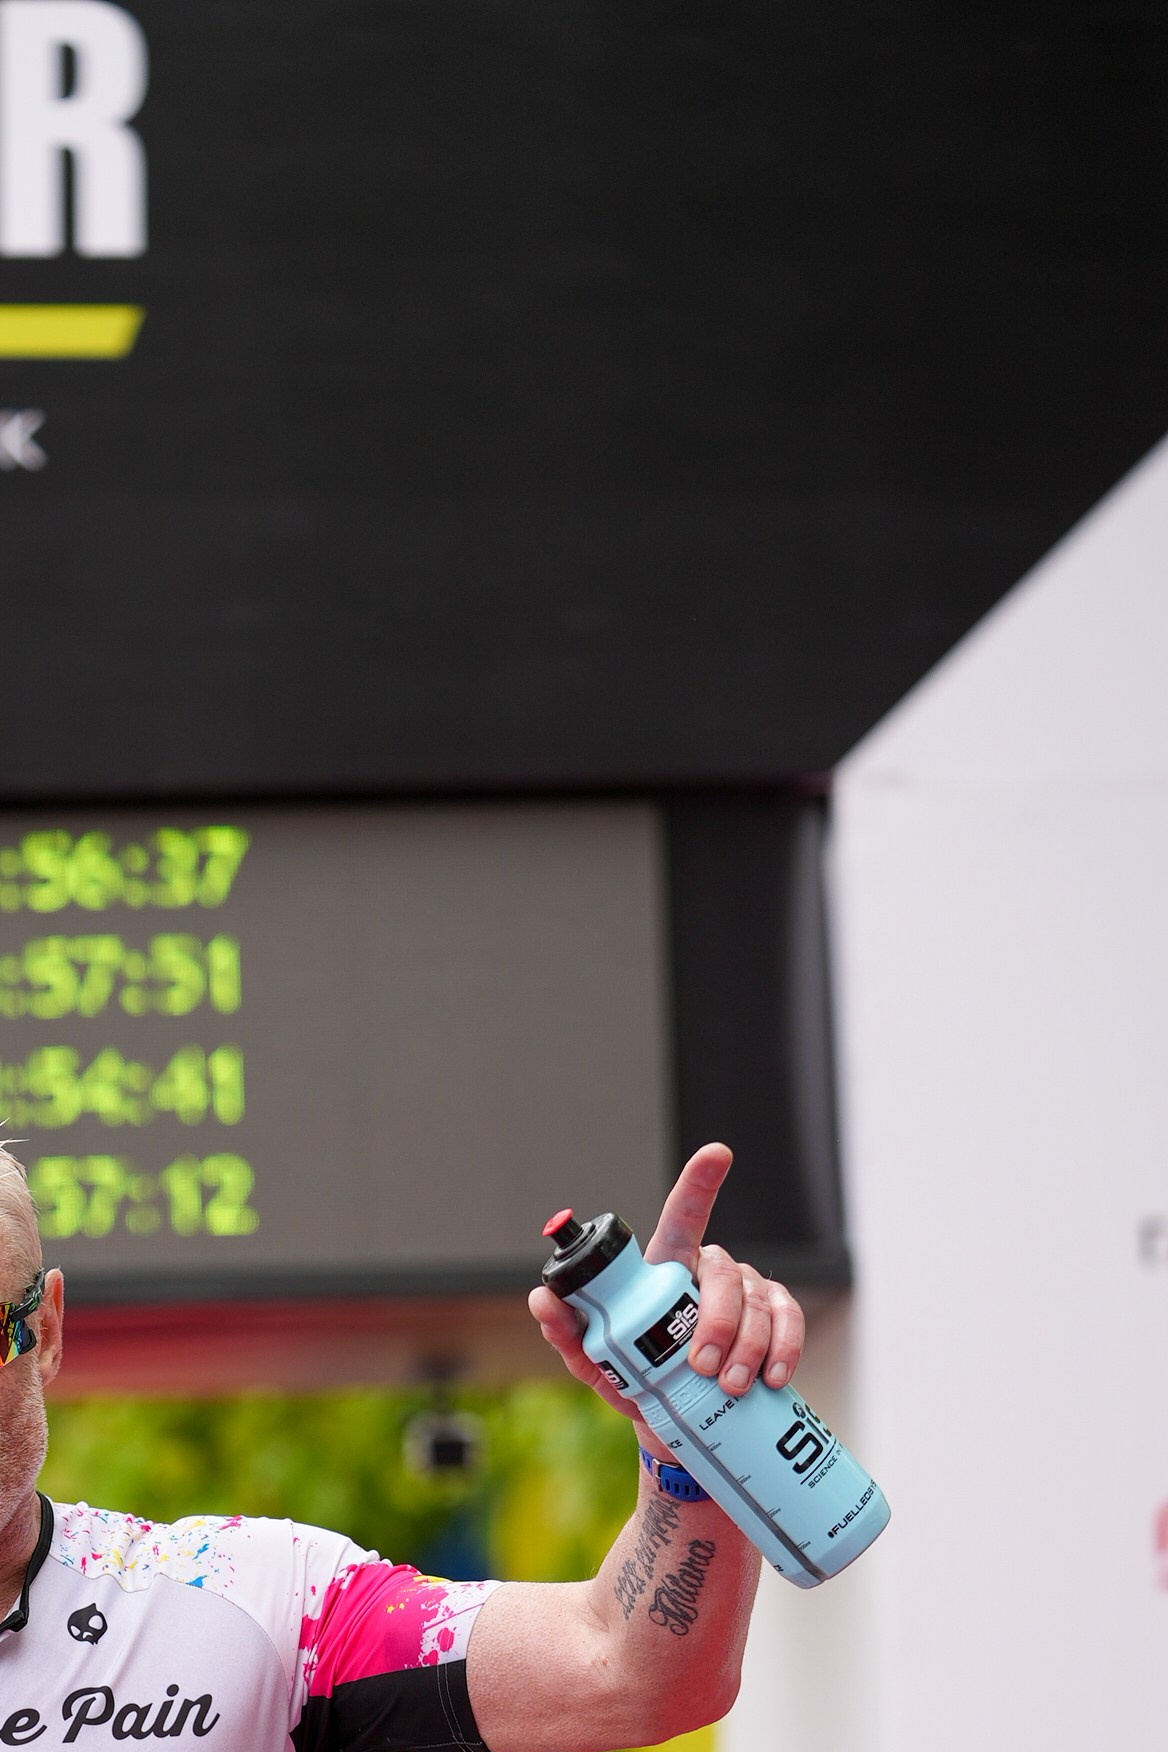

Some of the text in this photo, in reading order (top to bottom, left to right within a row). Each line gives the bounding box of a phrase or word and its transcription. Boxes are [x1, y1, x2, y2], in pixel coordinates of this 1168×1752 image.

[699, 1399, 737, 1431] LEAVE
[808, 1455, 838, 1489] SCIENCE
[62, 1683, 221, 1745] Pain
